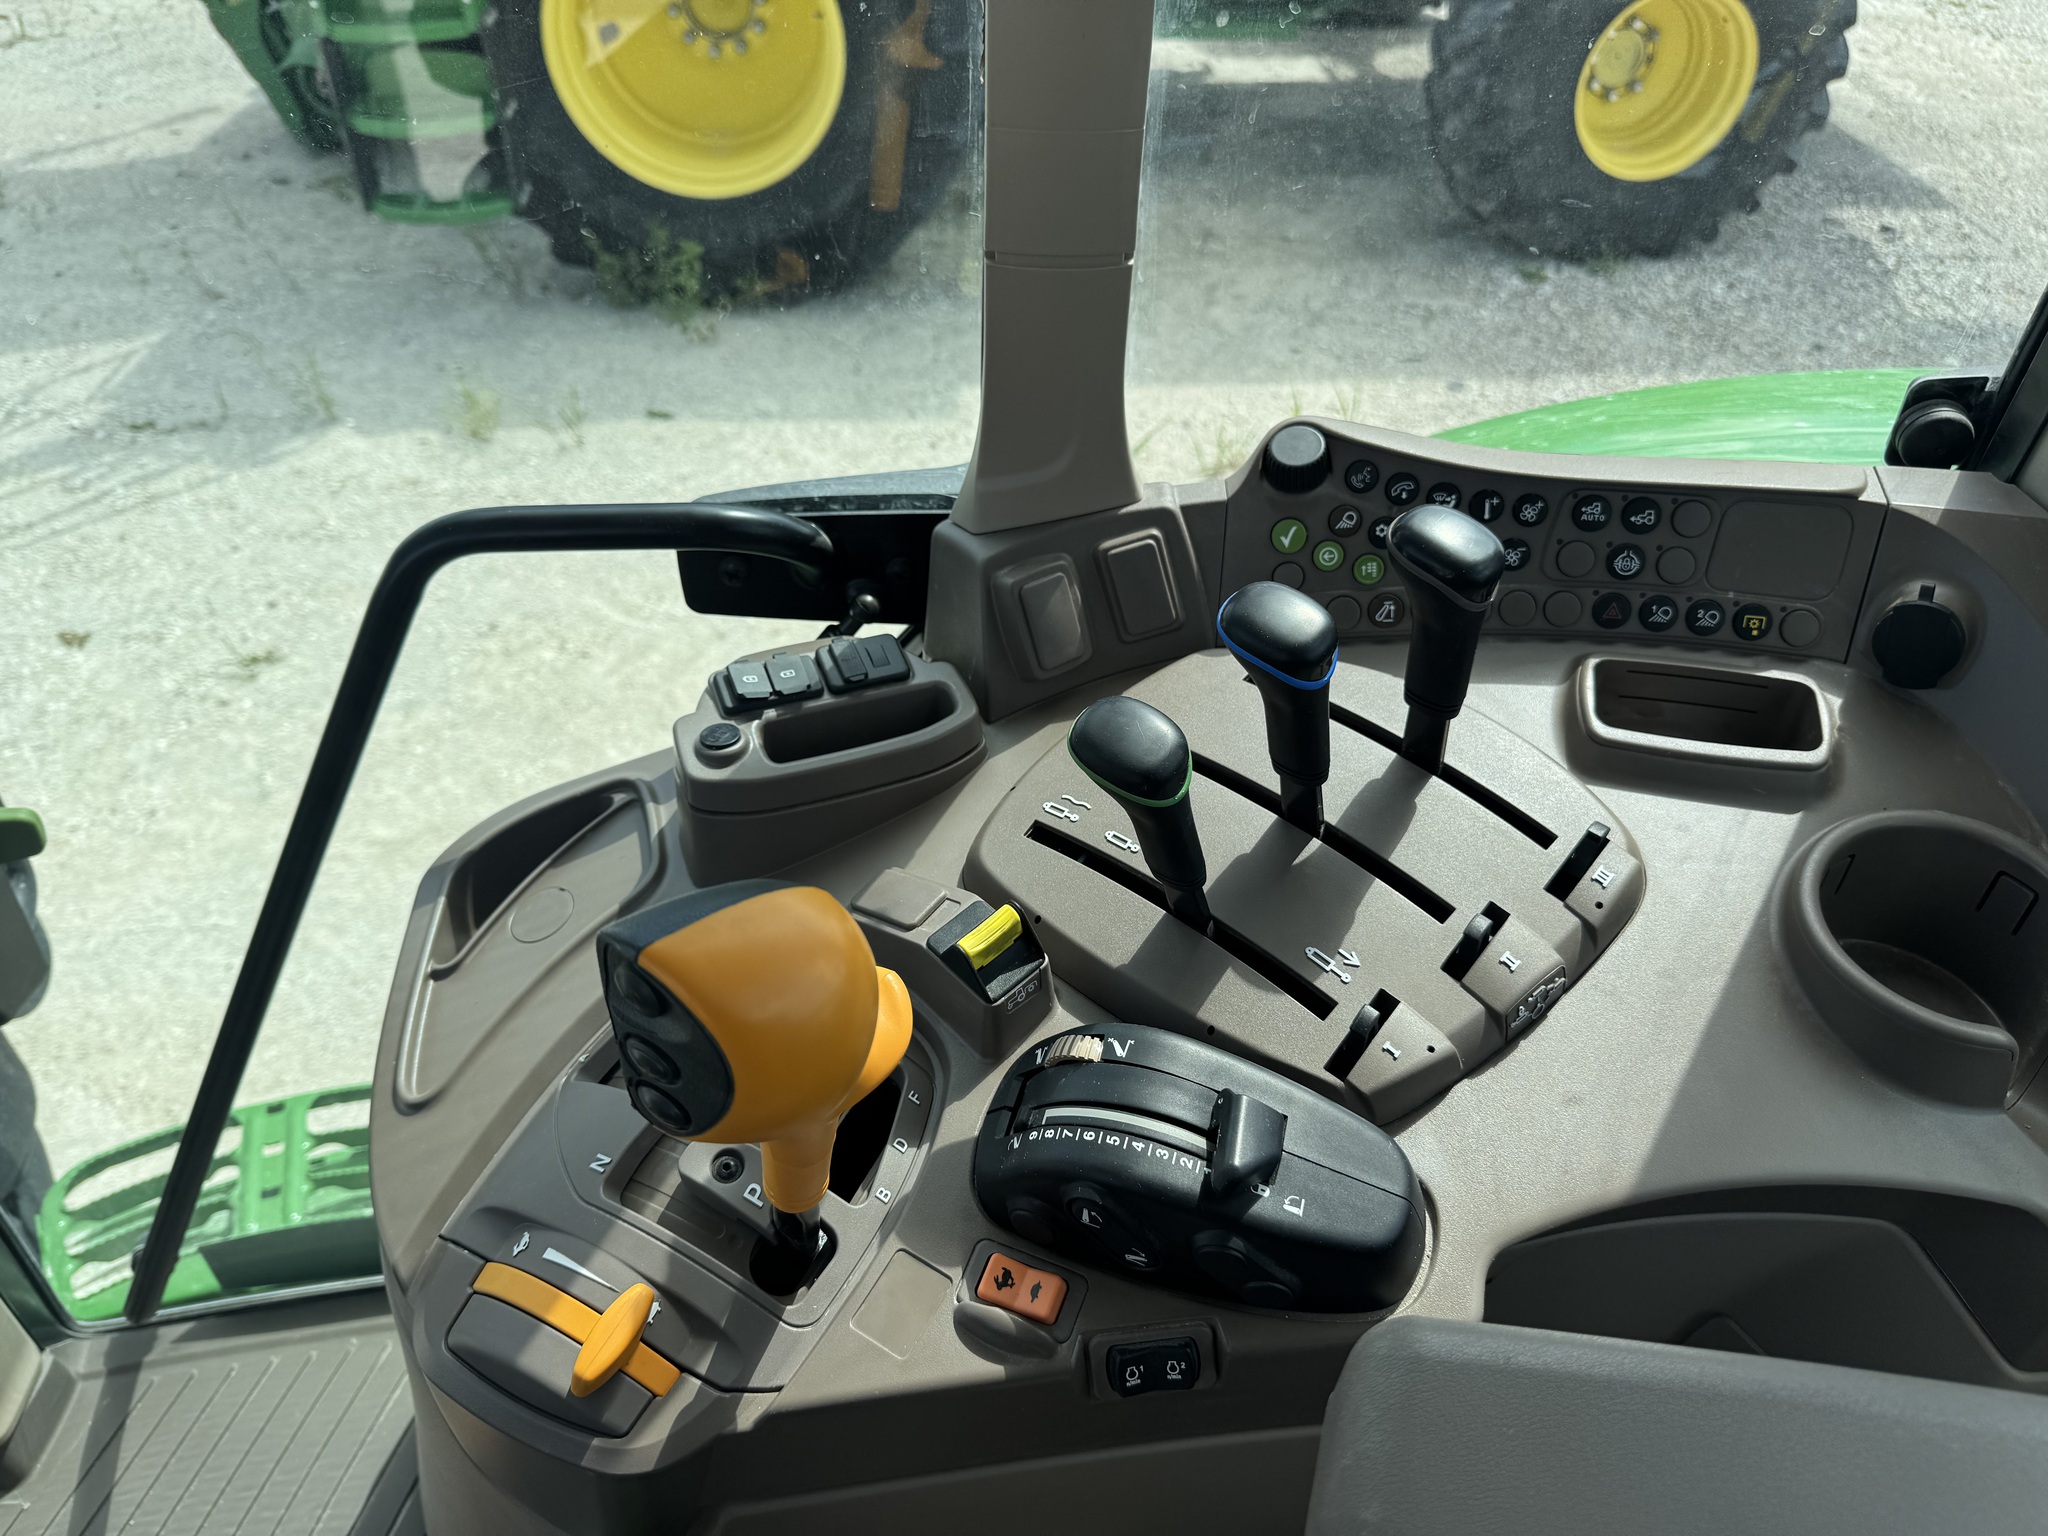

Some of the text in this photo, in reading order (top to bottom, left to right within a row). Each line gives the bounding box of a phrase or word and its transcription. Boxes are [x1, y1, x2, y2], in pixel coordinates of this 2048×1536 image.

[1580, 513, 1605, 522] AUTO
[1651, 605, 1657, 614] 1
[1697, 609, 1704, 618] 2
[907, 1090, 921, 1105] F
[892, 1137, 908, 1154] D
[1029, 1130, 1038, 1140] 9
[1044, 1128, 1055, 1139] 8
[1062, 1128, 1074, 1138] 7
[1083, 1130, 1096, 1141] 6
[1105, 1135, 1120, 1146] 5
[1131, 1140, 1146, 1152] 4
[1156, 1147, 1170, 1160] 3
[1179, 1157, 1194, 1170] 2
[588, 1153, 613, 1174] N
[742, 1182, 764, 1208] P
[875, 1186, 892, 1204] B
[1139, 1365, 1144, 1373] 1
[1180, 1361, 1186, 1369] 2
